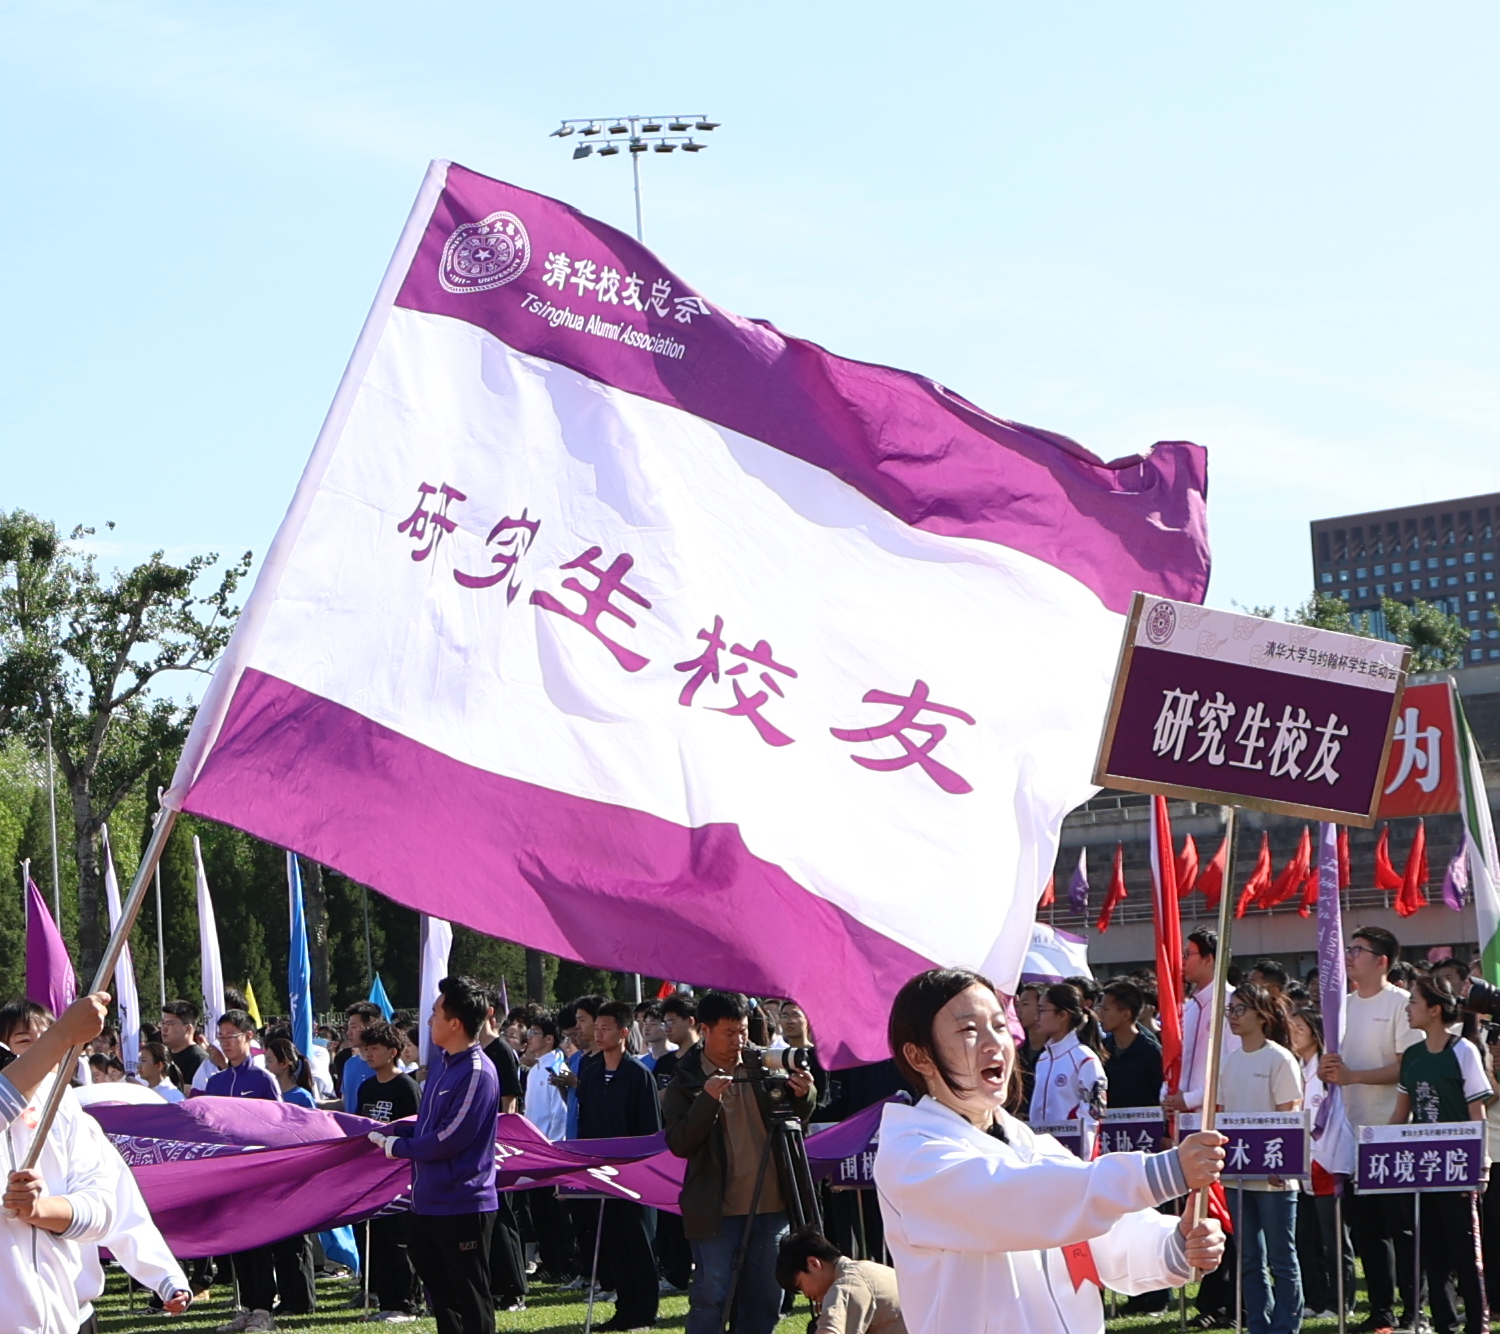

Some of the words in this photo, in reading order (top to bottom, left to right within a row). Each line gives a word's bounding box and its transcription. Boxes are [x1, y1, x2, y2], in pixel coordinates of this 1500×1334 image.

[541, 250, 712, 325] 清华校友总会
[520, 291, 584, 332] Tsinghua
[585, 313, 625, 340] Alumni
[620, 327, 686, 360] Association
[397, 481, 977, 796] 研究生校友
[1264, 640, 1398, 681] 清华大学马约翰杯学生运动会
[1151, 686, 1350, 786] 研究生校友
[1384, 707, 1442, 794] 为
[1368, 1147, 1470, 1185] 环境学院
